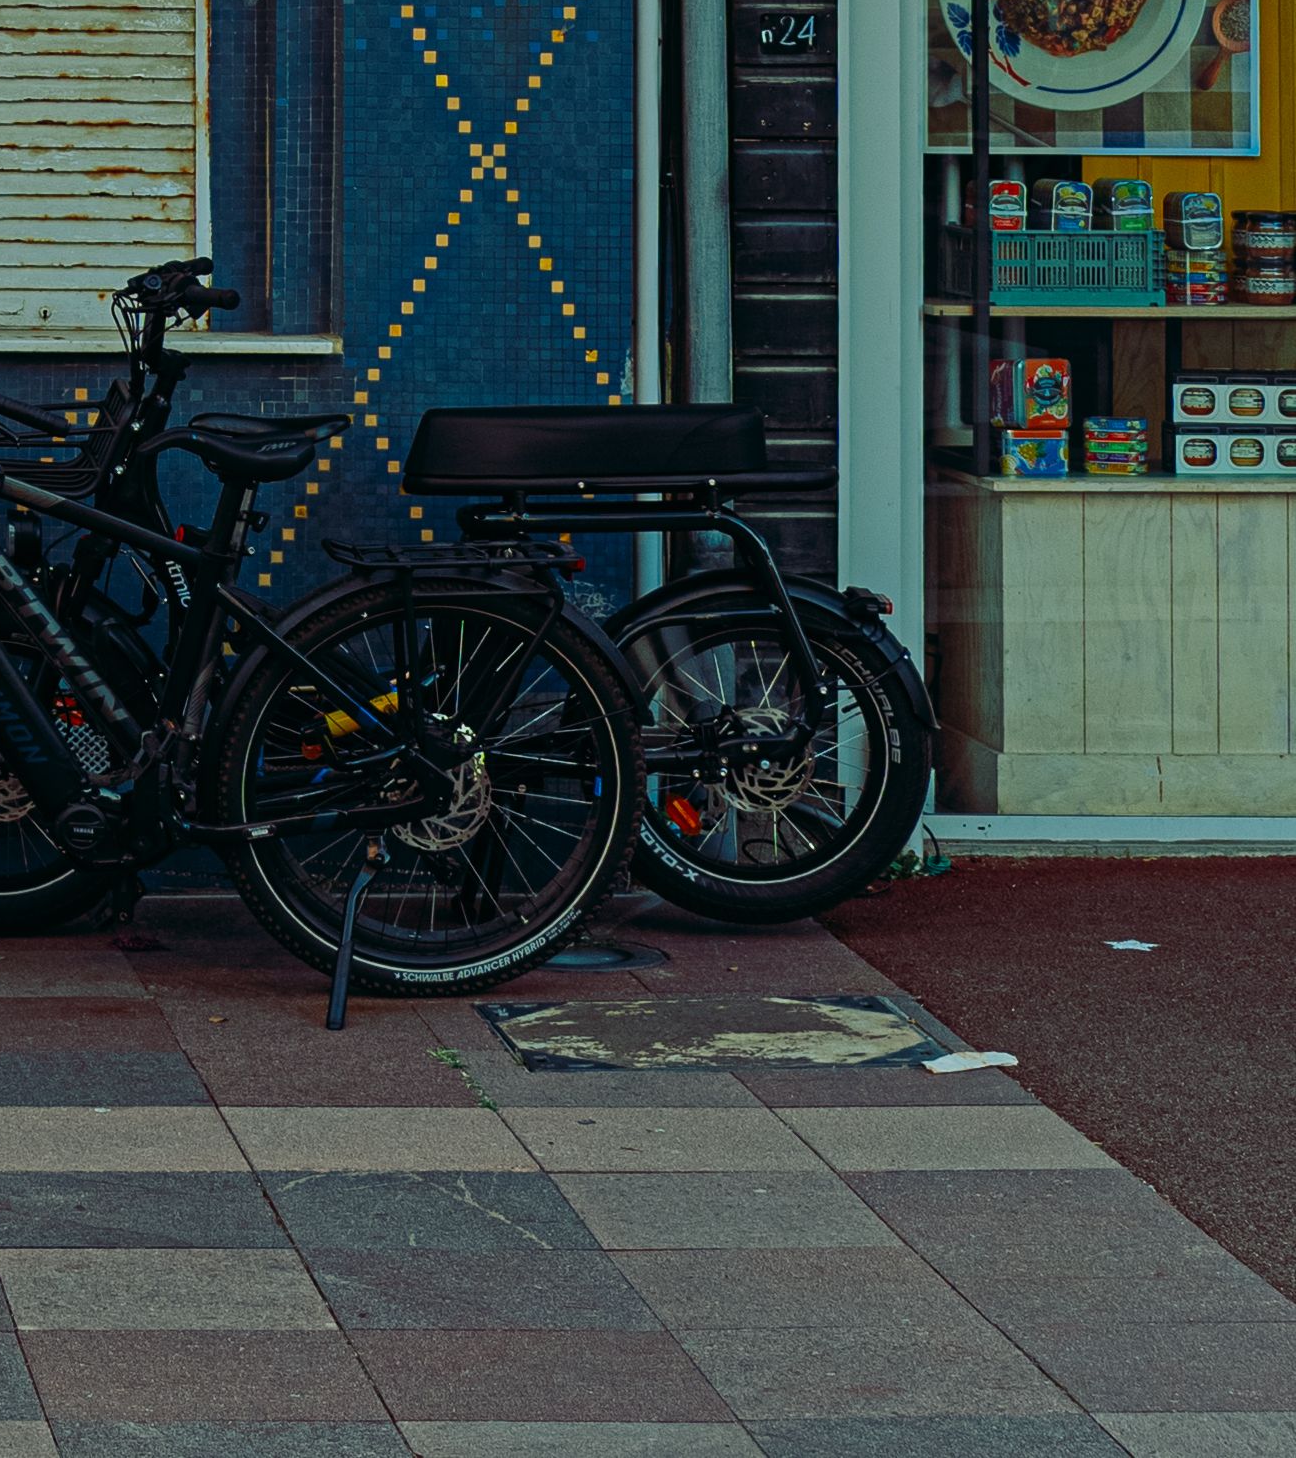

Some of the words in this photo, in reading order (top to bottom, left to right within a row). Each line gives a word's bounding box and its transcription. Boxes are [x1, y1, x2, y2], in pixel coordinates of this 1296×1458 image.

[779, 15, 816, 46] 24
[401, 971, 455, 983] SCHWALBE
[456, 955, 512, 980] ADVANCER
[512, 936, 547, 962] HYBRID
